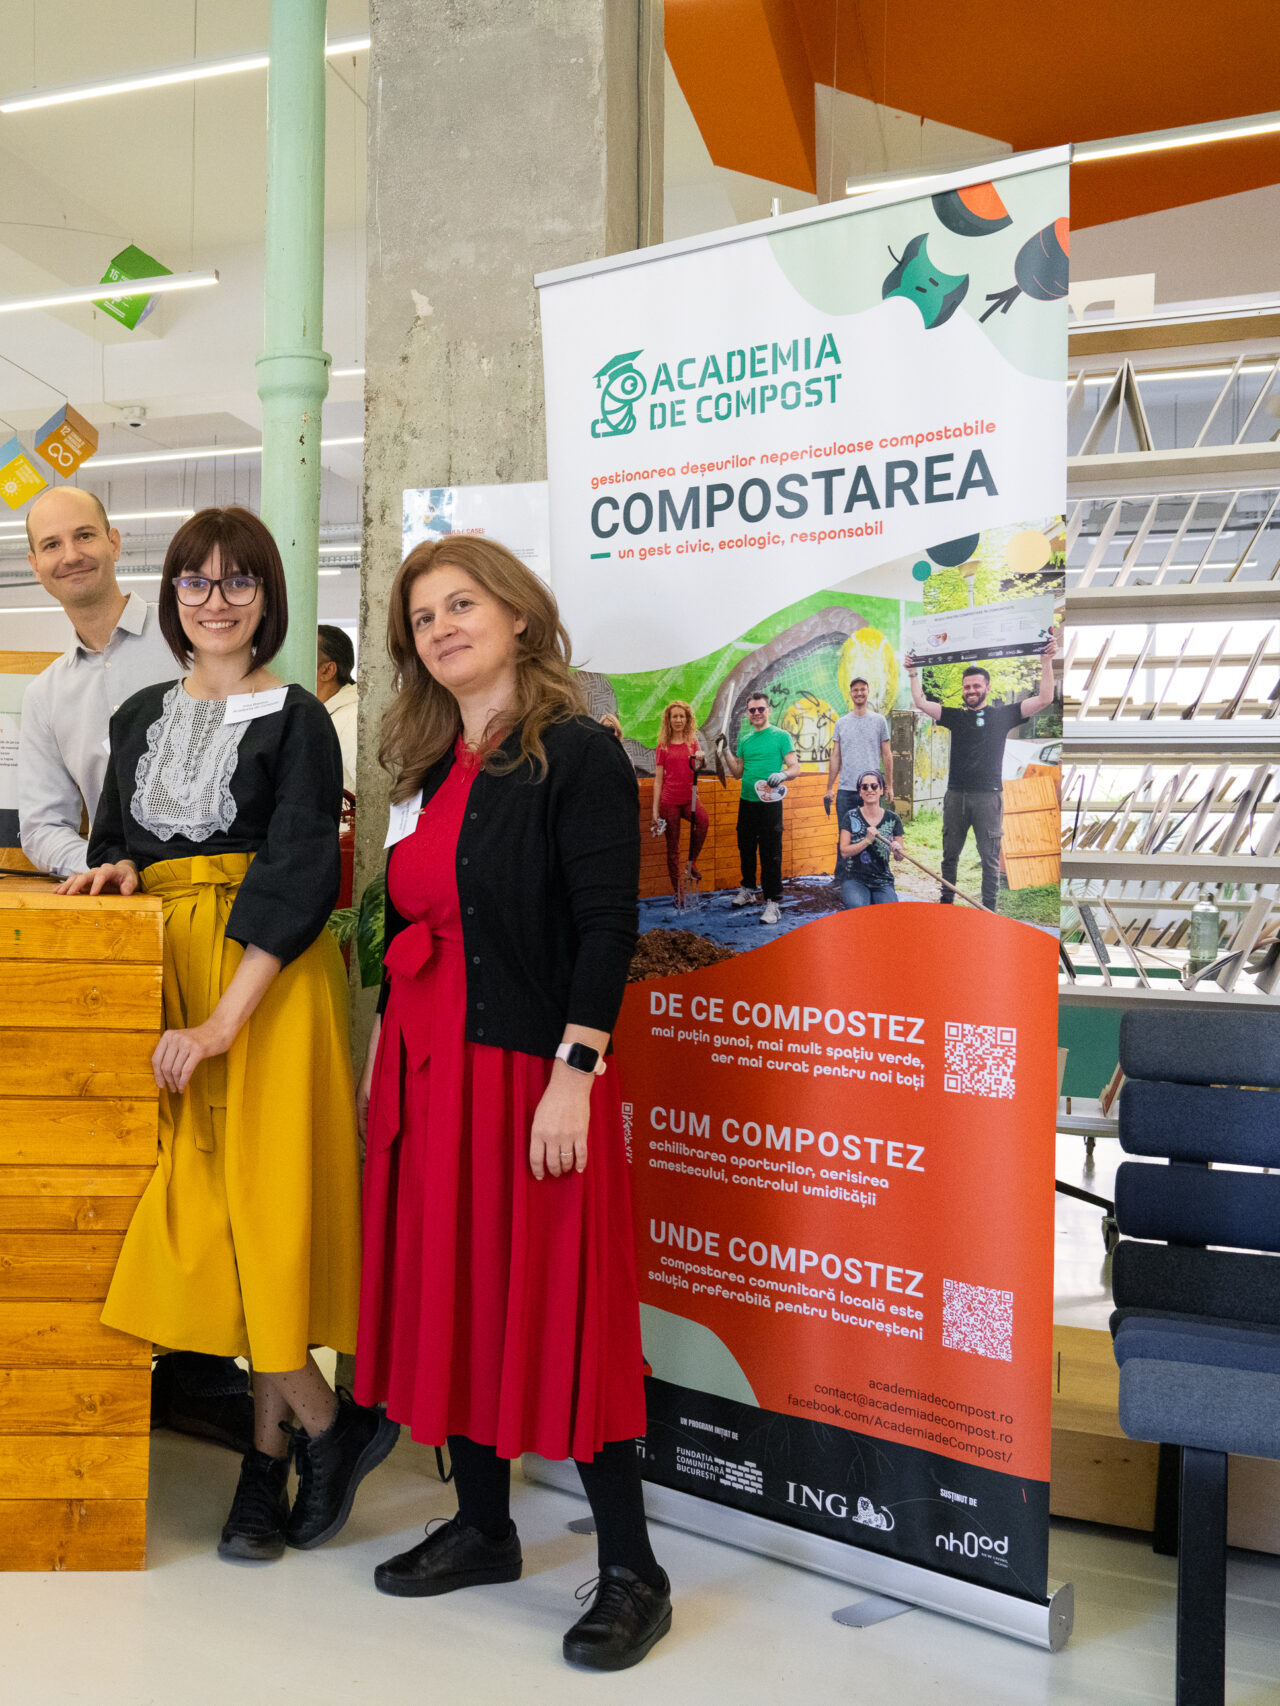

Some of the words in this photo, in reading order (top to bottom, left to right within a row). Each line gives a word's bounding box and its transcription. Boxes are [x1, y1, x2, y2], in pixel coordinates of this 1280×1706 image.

[650, 333, 841, 395] ACADEMIA
[650, 399, 686, 430] DE
[696, 373, 842, 423] COMPOST
[591, 467, 676, 489] gestionarea
[681, 454, 756, 477] deșeurilor
[760, 439, 874, 465] nepericuloase
[879, 419, 996, 449] compostabile
[591, 449, 999, 538] COMPOSTAREA
[618, 547, 634, 559] un
[638, 542, 671, 560] gest
[675, 537, 715, 554] civic,
[718, 528, 786, 551] ecologic,
[790, 520, 883, 545] responsabil
[650, 991, 683, 1018] DE
[690, 996, 724, 1023] CE
[732, 1000, 925, 1044] COMPOSTEZ
[651, 1026, 674, 1038] mai
[677, 1028, 710, 1044] puțin
[713, 1034, 753, 1050] gunoi,
[757, 1039, 783, 1051] mai
[787, 1042, 822, 1056] mult
[826, 1046, 874, 1063] spațiu
[878, 1052, 925, 1070] verde,
[711, 1052, 734, 1064] aer
[738, 1055, 762, 1068] mai
[766, 1059, 809, 1073] curat
[813, 1063, 866, 1079] pentru
[869, 1070, 892, 1083] noi
[896, 1072, 925, 1091] toți
[649, 1139, 727, 1164] echilibrarea
[730, 1155, 816, 1179] aporturilor,
[820, 1169, 889, 1189] aerisirea
[650, 1106, 710, 1139] CUM
[722, 1118, 925, 1172] COMPOSTEZ
[649, 1158, 729, 1184] amestecului,
[732, 1174, 798, 1193] controlul
[802, 1186, 876, 1208] umidității
[650, 1218, 720, 1257] UNDE
[728, 1237, 924, 1298] COMPOSTEZ
[648, 1269, 689, 1289] soluția
[692, 1281, 771, 1308] preferabilă
[775, 1300, 827, 1319] pentru
[831, 1308, 923, 1340] bucureșteni
[660, 1256, 745, 1284] compostarea
[748, 1277, 835, 1301] comunitară
[839, 1291, 885, 1312] locală
[889, 1305, 924, 1320] este
[814, 1384, 1013, 1444] contact@academiadecompost.ro
[869, 1379, 1013, 1425] academiadecompost.ro
[688, 1419, 714, 1432] PROGRAM
[731, 1431, 739, 1440] DE
[788, 1394, 1013, 1463] facebook.com/AcademiadeCompost/
[676, 1446, 713, 1463] FUNDAȚIA
[676, 1455, 725, 1476] COMUNITARĂ
[676, 1464, 716, 1481] BUCUREȘTI
[786, 1481, 848, 1518] ING
[968, 1497, 978, 1507] DE
